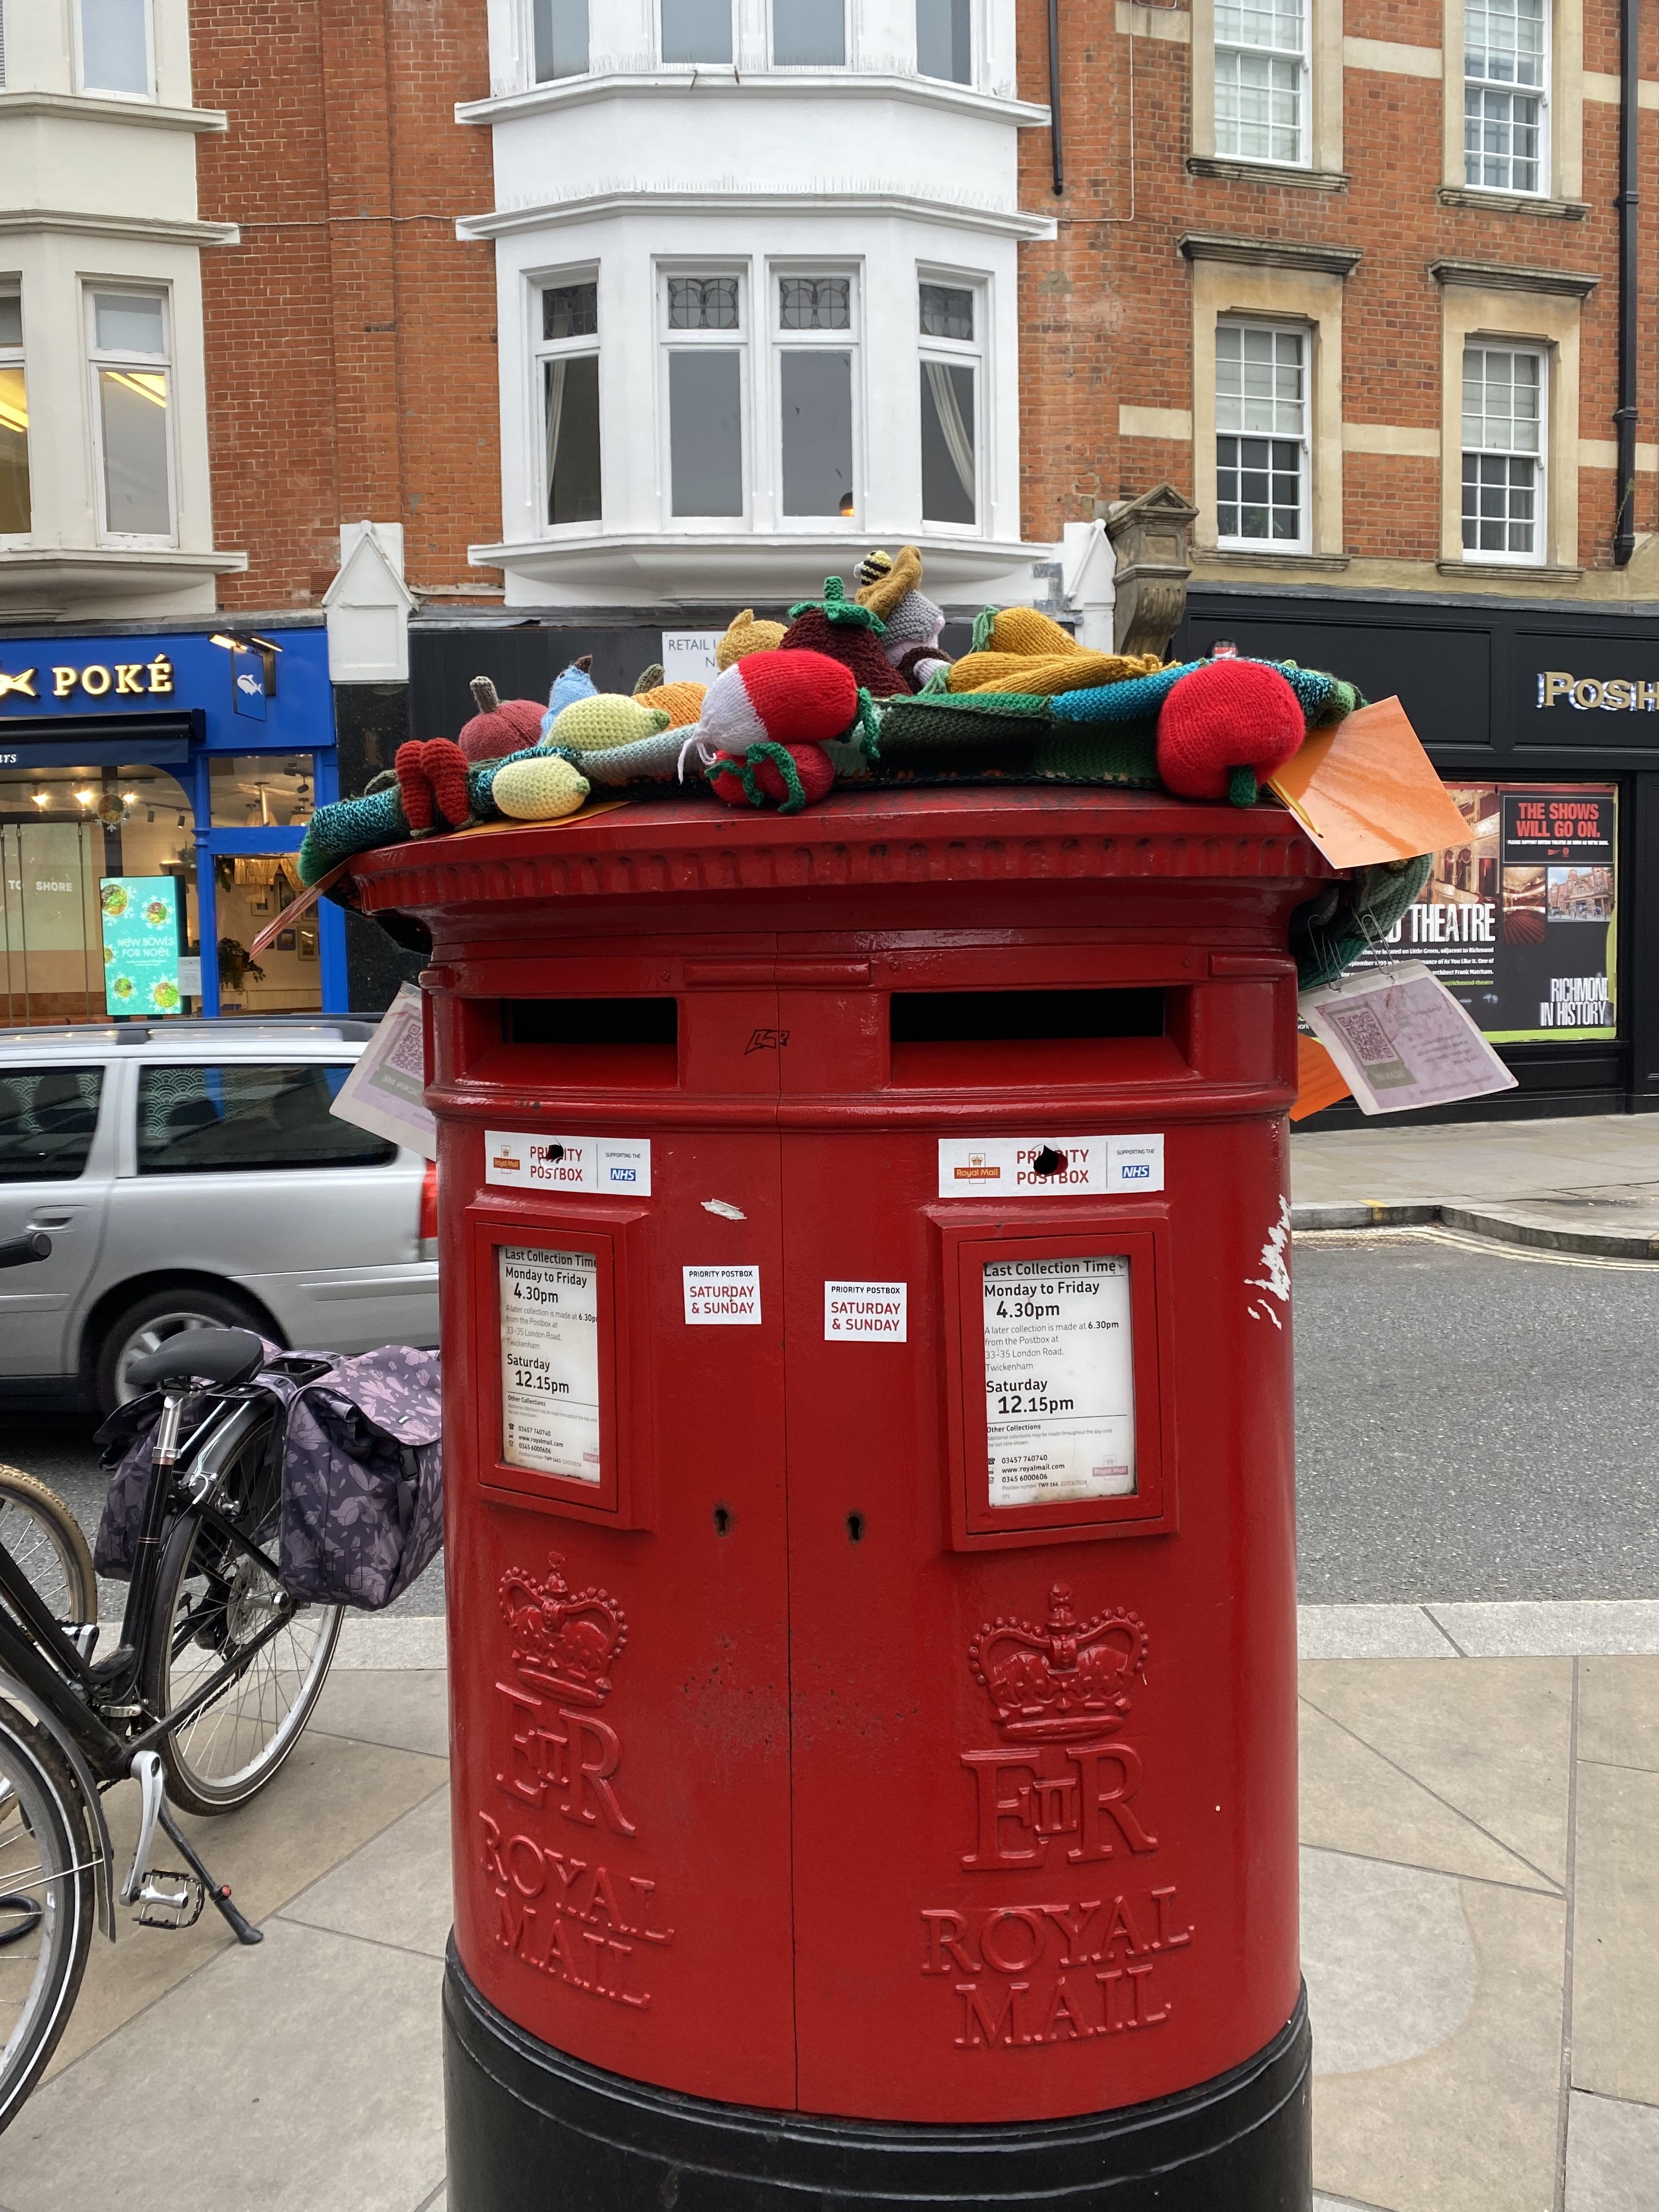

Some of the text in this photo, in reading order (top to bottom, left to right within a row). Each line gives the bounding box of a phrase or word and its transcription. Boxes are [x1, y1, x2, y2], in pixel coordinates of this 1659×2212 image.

[669, 639, 709, 650] RETAIL
[52, 653, 173, 696] POKÉ
[1539, 672, 1659, 709] POSH
[1519, 803, 1599, 820] THE SHOWS
[1516, 821, 1601, 837] WILL GO ON.
[8, 880, 72, 891] TO SHORE
[1409, 904, 1496, 942] THEATRE
[143, 937, 174, 946] BOWLS
[122, 949, 140, 957] FOR
[1541, 1001, 1606, 1026] IN HISTORY
[531, 1146, 582, 1161] PRIITY
[1017, 1149, 1089, 1164] PRITY
[531, 1165, 583, 1182] POSTBOX
[611, 1169, 635, 1180] NHS
[957, 1169, 979, 1178] Royal
[1124, 1166, 1148, 1178] NHS
[505, 1248, 524, 1260] Last
[527, 1250, 572, 1265] Collection
[506, 1266, 587, 1288] Monday to Friday
[984, 1265, 1012, 1277] Last
[1016, 1262, 1080, 1275] Collection
[514, 1282, 558, 1305] 4.30pm
[690, 1286, 754, 1297] SATURDAY
[984, 1281, 1099, 1297] Monday to Friday
[524, 1307, 549, 1316] collection
[578, 1313, 597, 1323] 6.30p
[692, 1302, 754, 1314] & SUNDAY
[831, 1302, 901, 1314] SATURDAY
[996, 1300, 1060, 1319] 4.30pm
[506, 1314, 518, 1323] from
[520, 1316, 528, 1324] the
[529, 1318, 551, 1327] Postbox
[832, 1318, 900, 1331] & SUNDAY
[992, 1325, 1009, 1334] later
[1011, 1324, 1046, 1333] collection
[1056, 1322, 1076, 1331] made
[1088, 1321, 1119, 1330] 6.30pm
[506, 1327, 523, 1335] 33-35
[525, 1329, 545, 1338] London
[506, 1338, 540, 1350] Twickenham
[985, 1350, 1010, 1359] 33-35
[1012, 1349, 1041, 1358] London
[507, 1354, 550, 1373] Saturday
[985, 1363, 1034, 1372] Twickenham
[516, 1370, 569, 1394] 12.15pm
[986, 1379, 1047, 1393] Saturday
[521, 1397, 546, 1406] Collections
[998, 1396, 1074, 1414] 12.15pm
[518, 1435, 563, 1448] www.royalmail.com
[1002, 1464, 1064, 1474] www.royalmail.com
[478, 1810, 675, 1945] ROYAL
[921, 1887, 1195, 1975] ROYAL
[495, 1887, 652, 2009] MAIL
[955, 1964, 1172, 2047] MAIL
